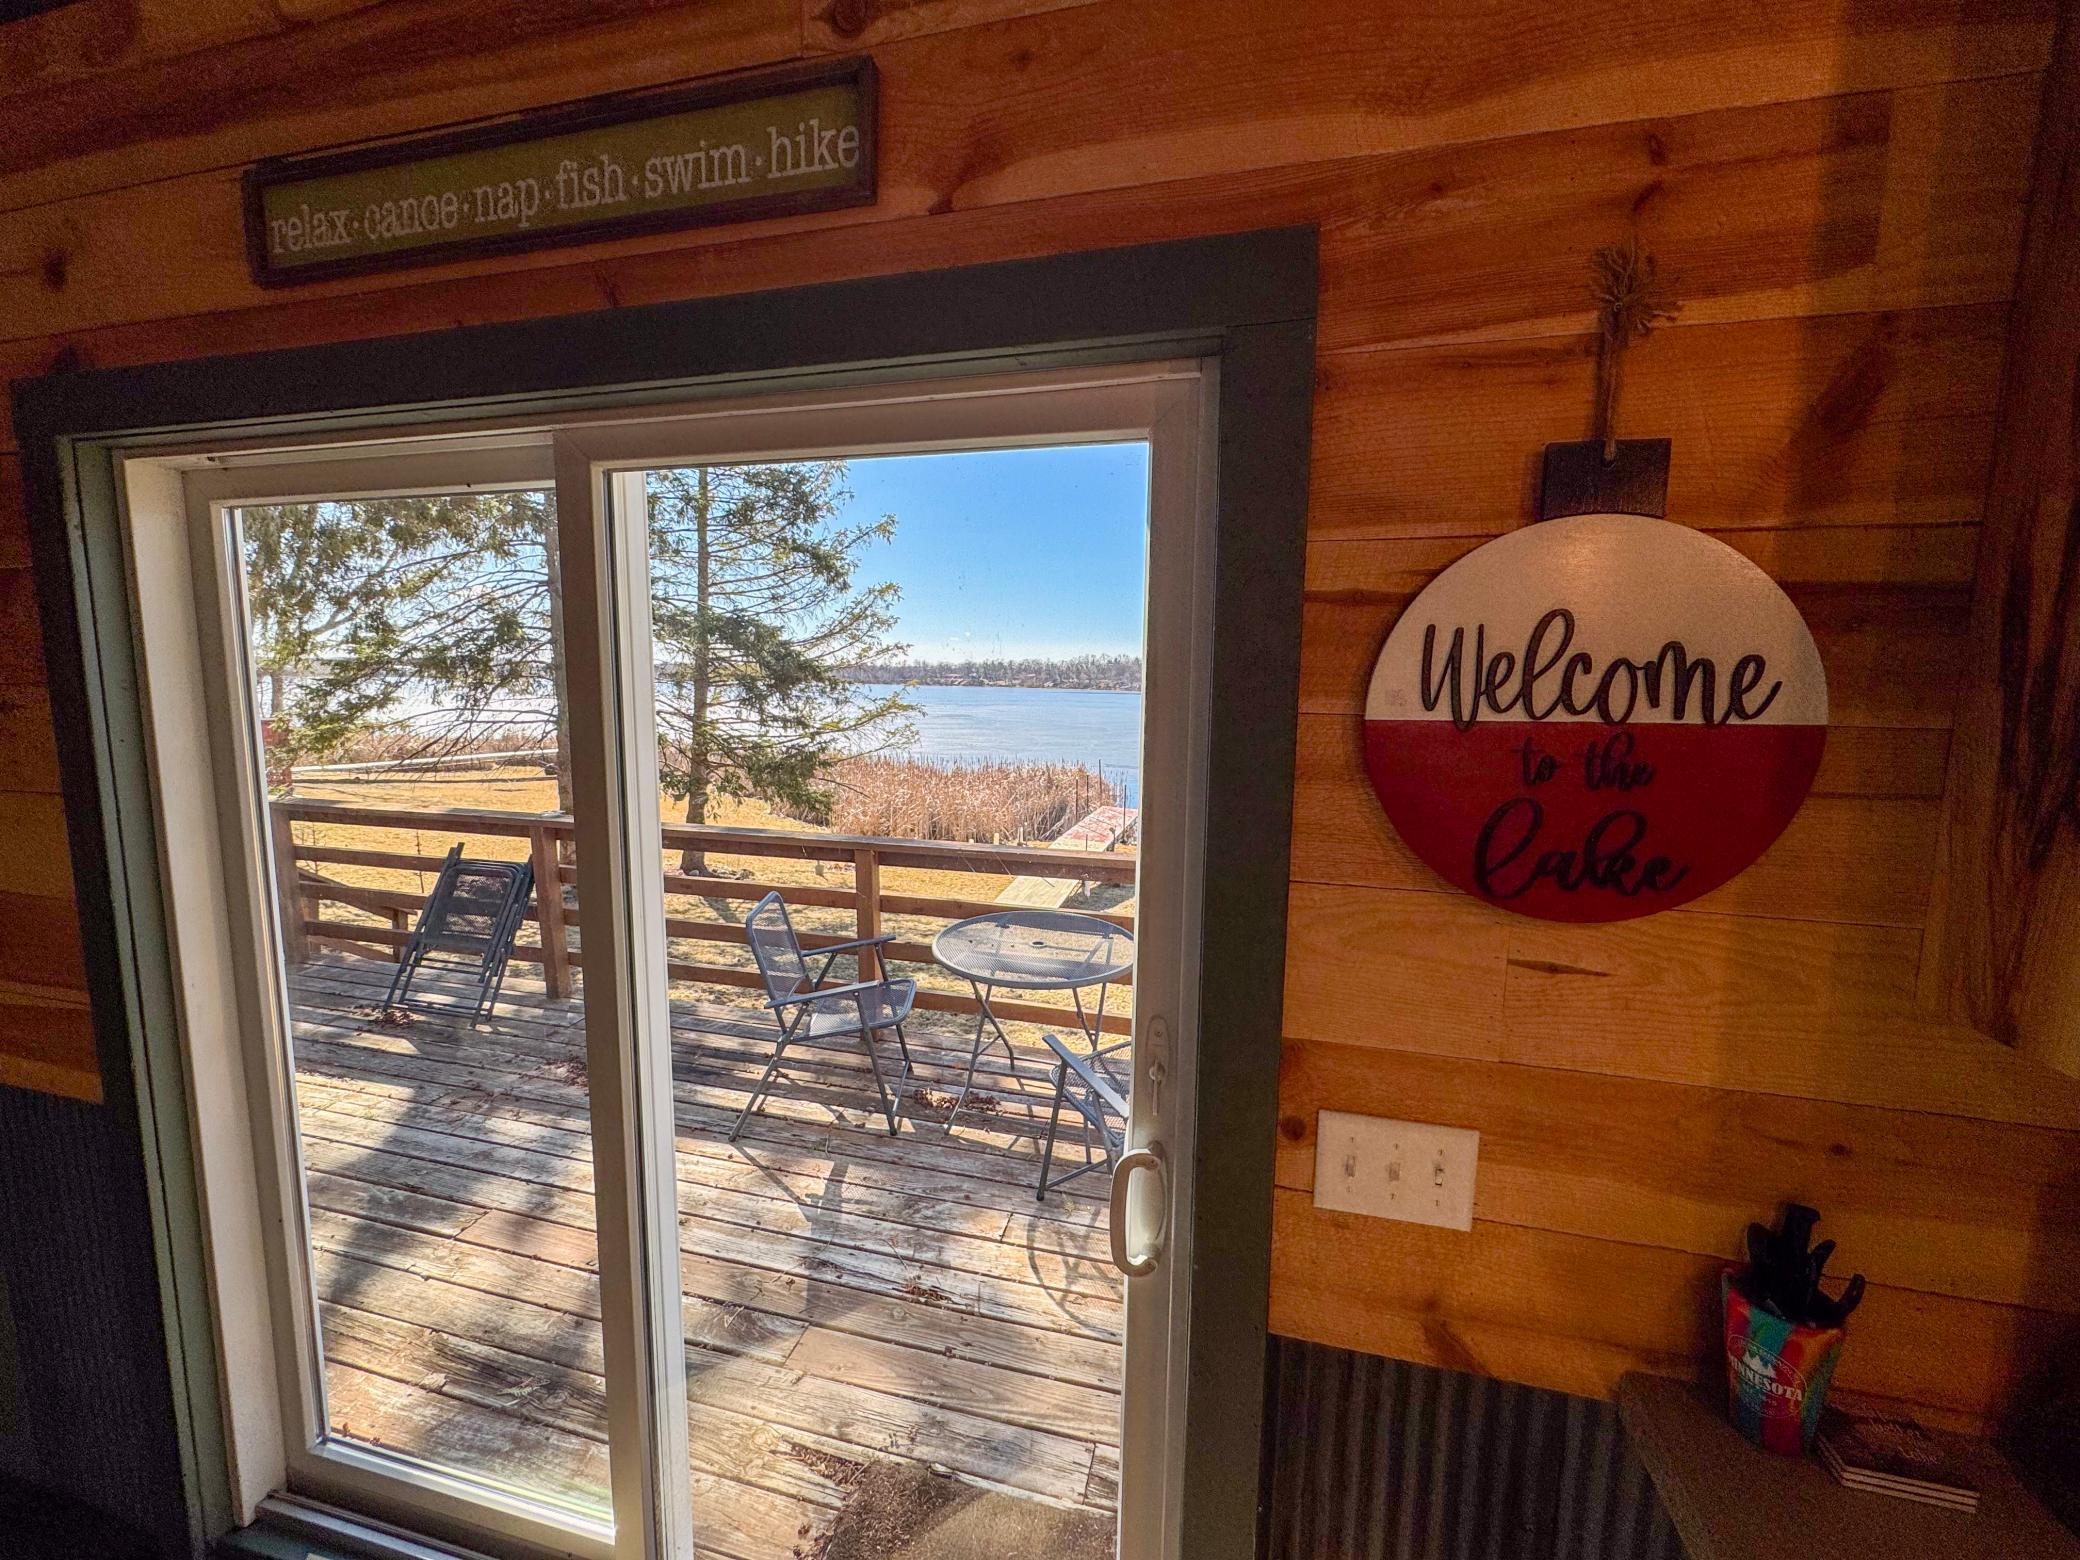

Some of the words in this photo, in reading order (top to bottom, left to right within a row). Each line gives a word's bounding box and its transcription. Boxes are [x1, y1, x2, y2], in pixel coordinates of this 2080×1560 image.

[474, 177, 540, 228] nap
[554, 152, 627, 210] fish
[644, 139, 750, 199] swim
[766, 118, 861, 179] hike
[1420, 608, 1783, 731] Welcome
[1512, 735, 1561, 787] to
[1577, 732, 1656, 790] the
